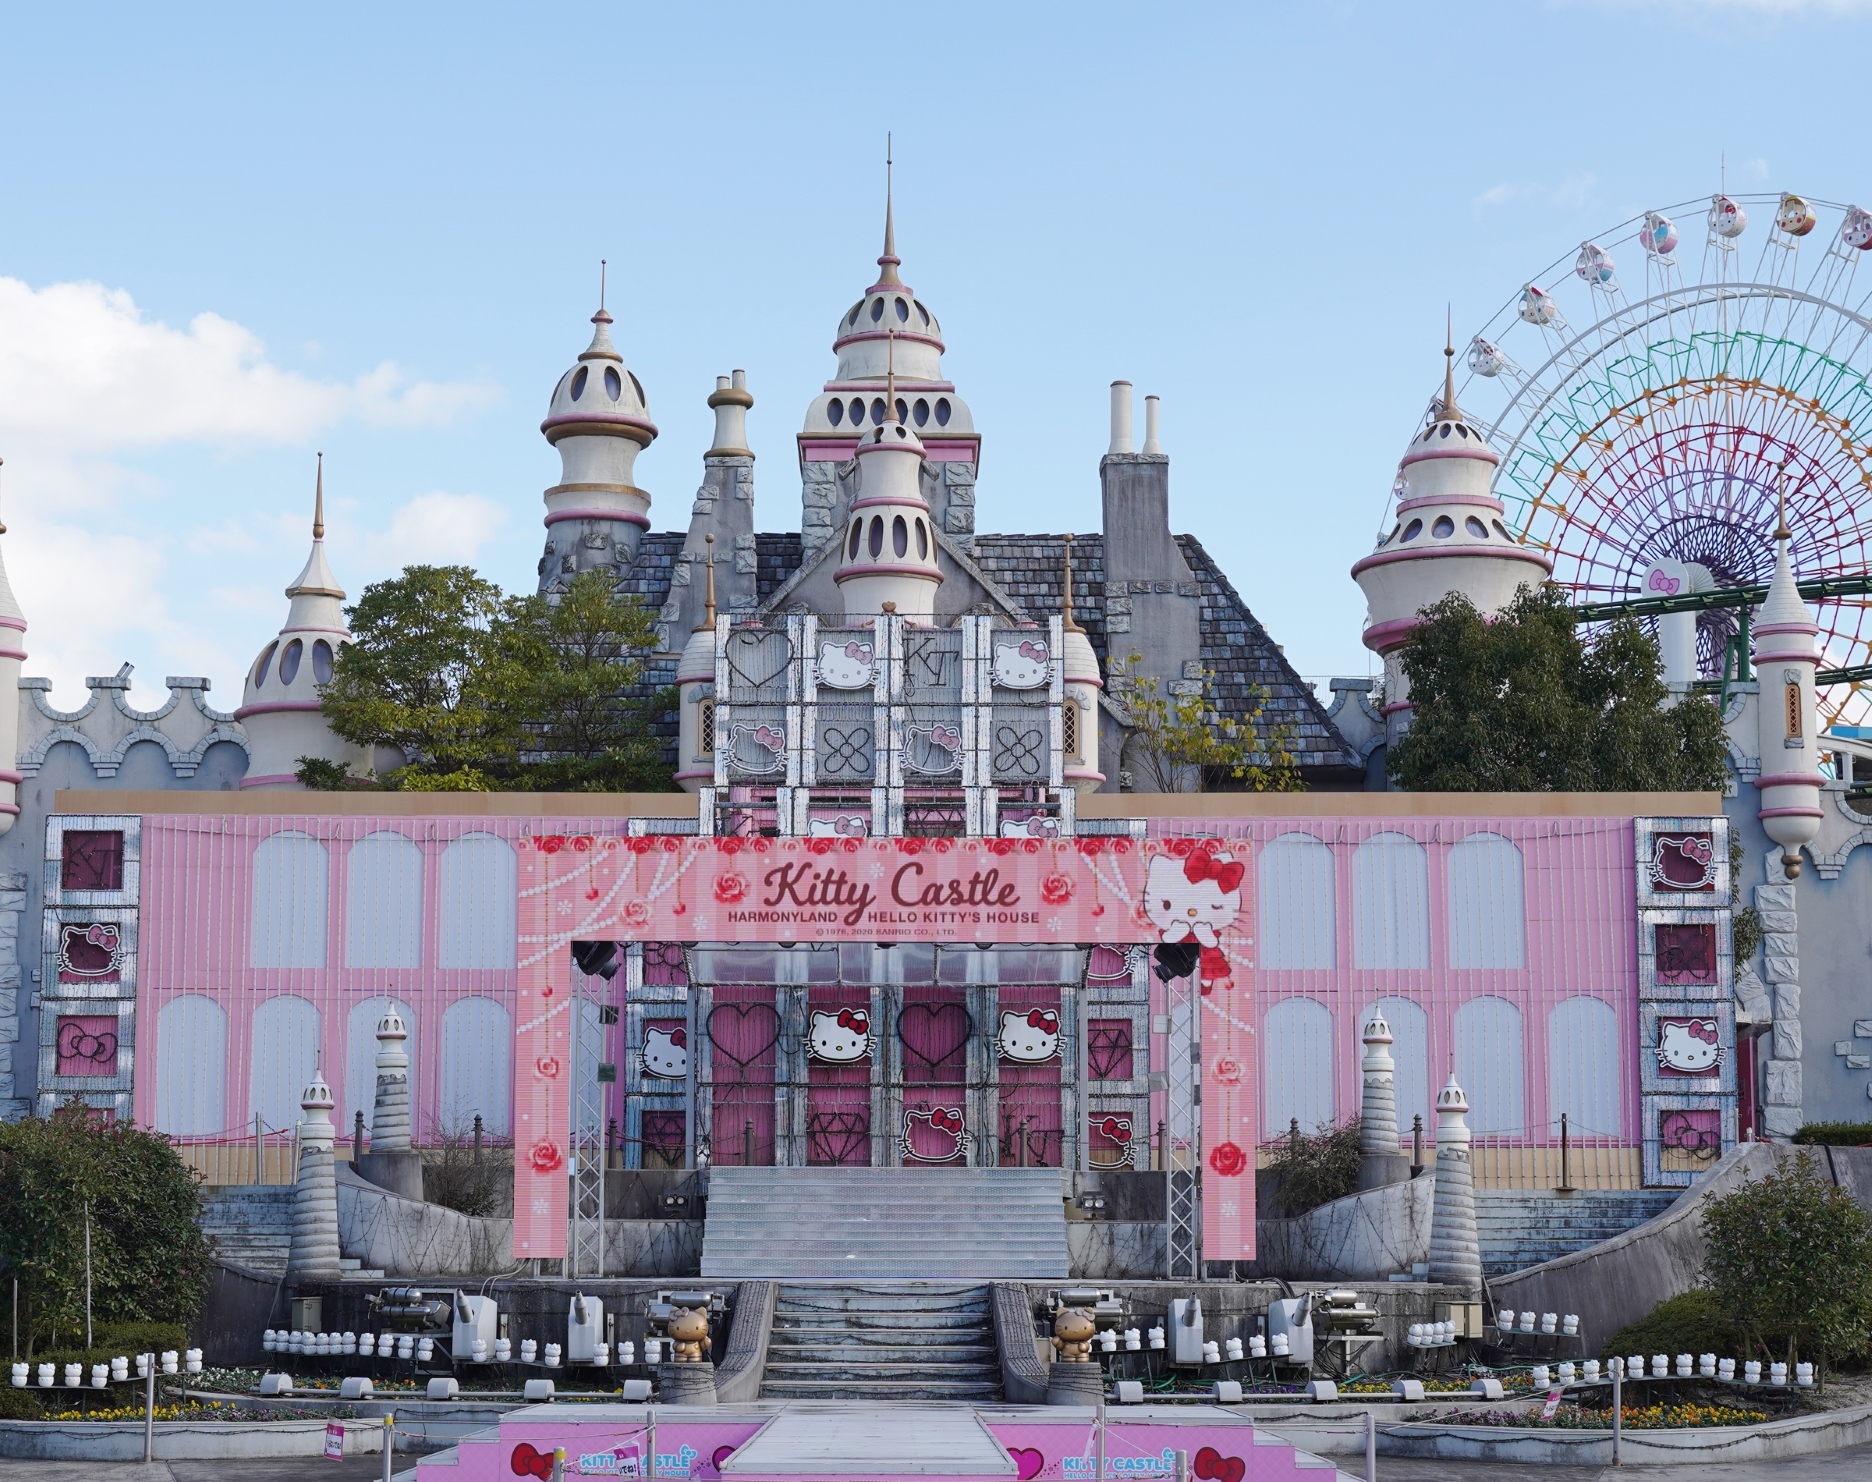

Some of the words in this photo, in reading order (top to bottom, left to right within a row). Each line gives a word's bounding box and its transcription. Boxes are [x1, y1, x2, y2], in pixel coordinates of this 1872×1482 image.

[763, 861, 877, 926] Kitty
[891, 861, 1020, 907] Castle
[728, 911, 838, 923] HARMONYLAND
[868, 911, 918, 923] HELLO
[923, 911, 981, 923] KITTY'S
[986, 911, 1040, 923] HOUSE
[851, 928, 873, 936] 2020
[876, 928, 911, 936] SANRIO
[936, 928, 957, 936] LTD.
[1113, 1457, 1172, 1471] CASTLE
